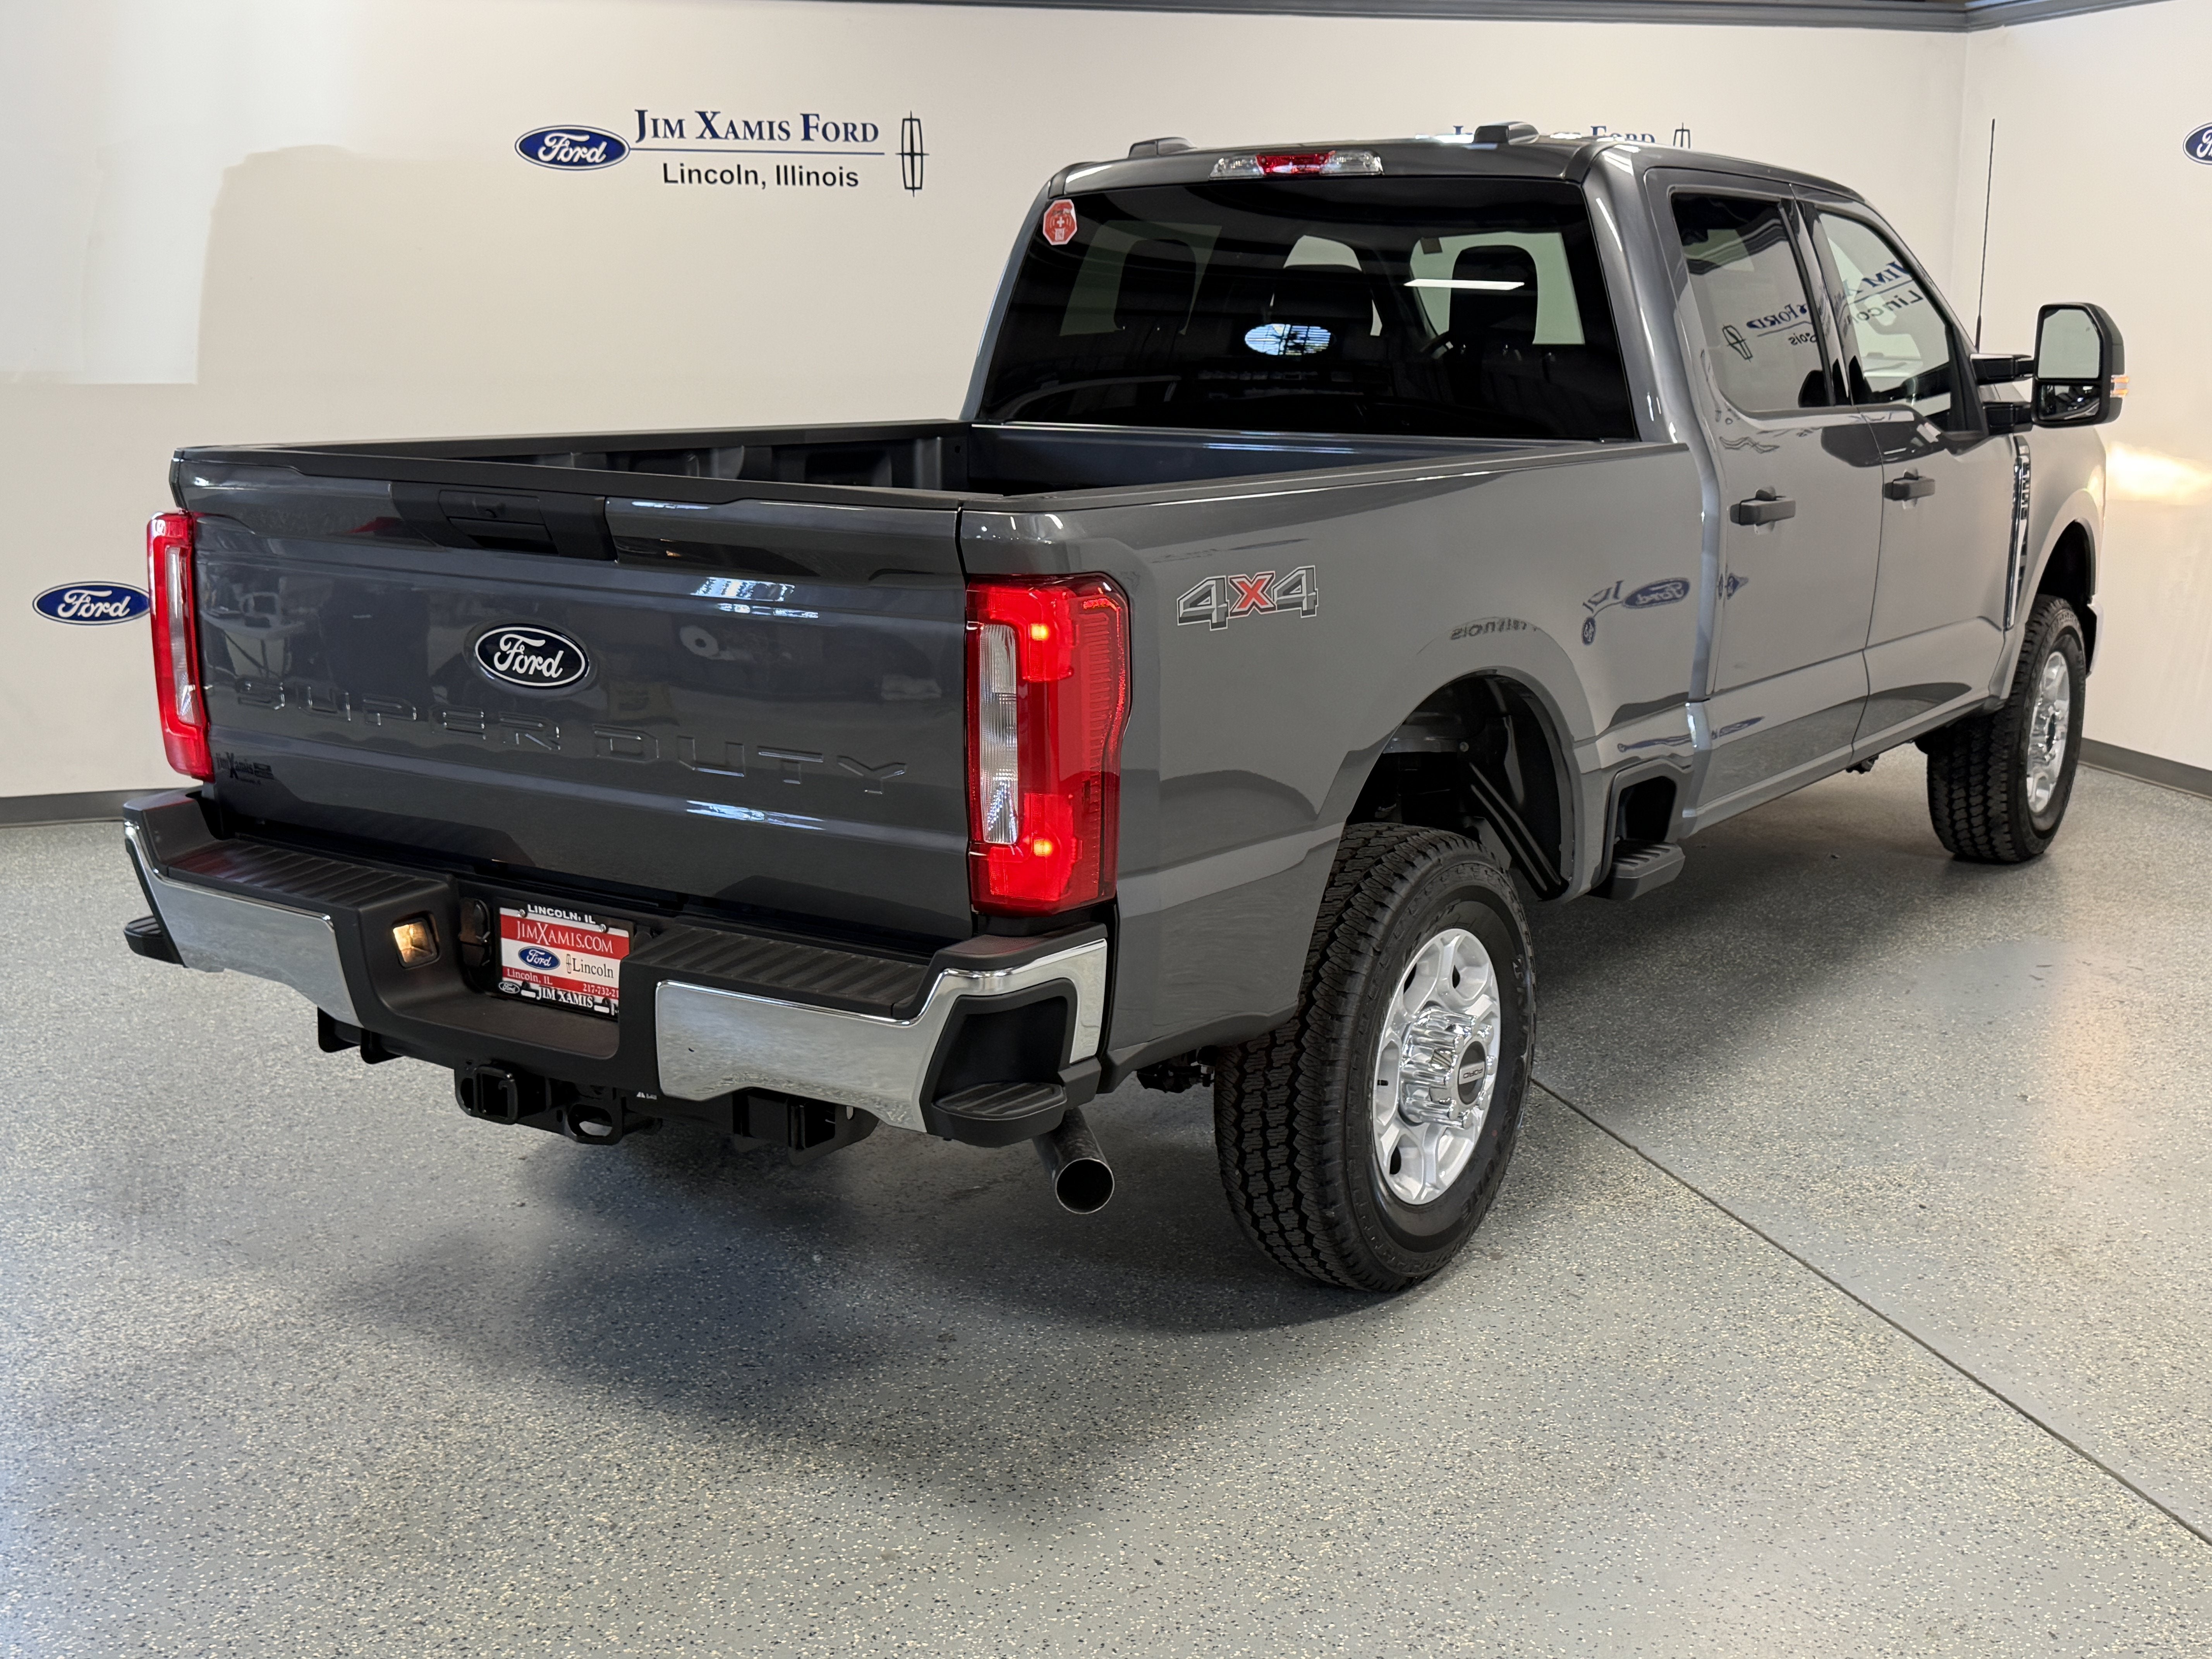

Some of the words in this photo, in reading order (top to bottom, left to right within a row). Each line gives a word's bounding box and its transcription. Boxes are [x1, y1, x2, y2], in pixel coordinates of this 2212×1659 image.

[634, 109, 685, 143] JIM
[695, 110, 791, 141] XAMIS
[800, 112, 879, 143] FORD
[538, 131, 606, 164] Ford
[663, 163, 766, 189] Lincoln,
[776, 165, 859, 187] Illinois
[58, 589, 131, 618] Ford
[494, 634, 564, 678] Ford
[235, 677, 561, 750] SUPER
[592, 723, 907, 794] DUTY
[527, 904, 581, 921] LINCOLN,
[584, 915, 596, 924] IL
[517, 921, 614, 954] JIMXAMIS.COM
[526, 949, 551, 967] Ford
[572, 957, 614, 979] Lincoln
[544, 976, 553, 985] IL
[536, 986, 557, 1000] JIM
[558, 990, 594, 1008] XAMIS
